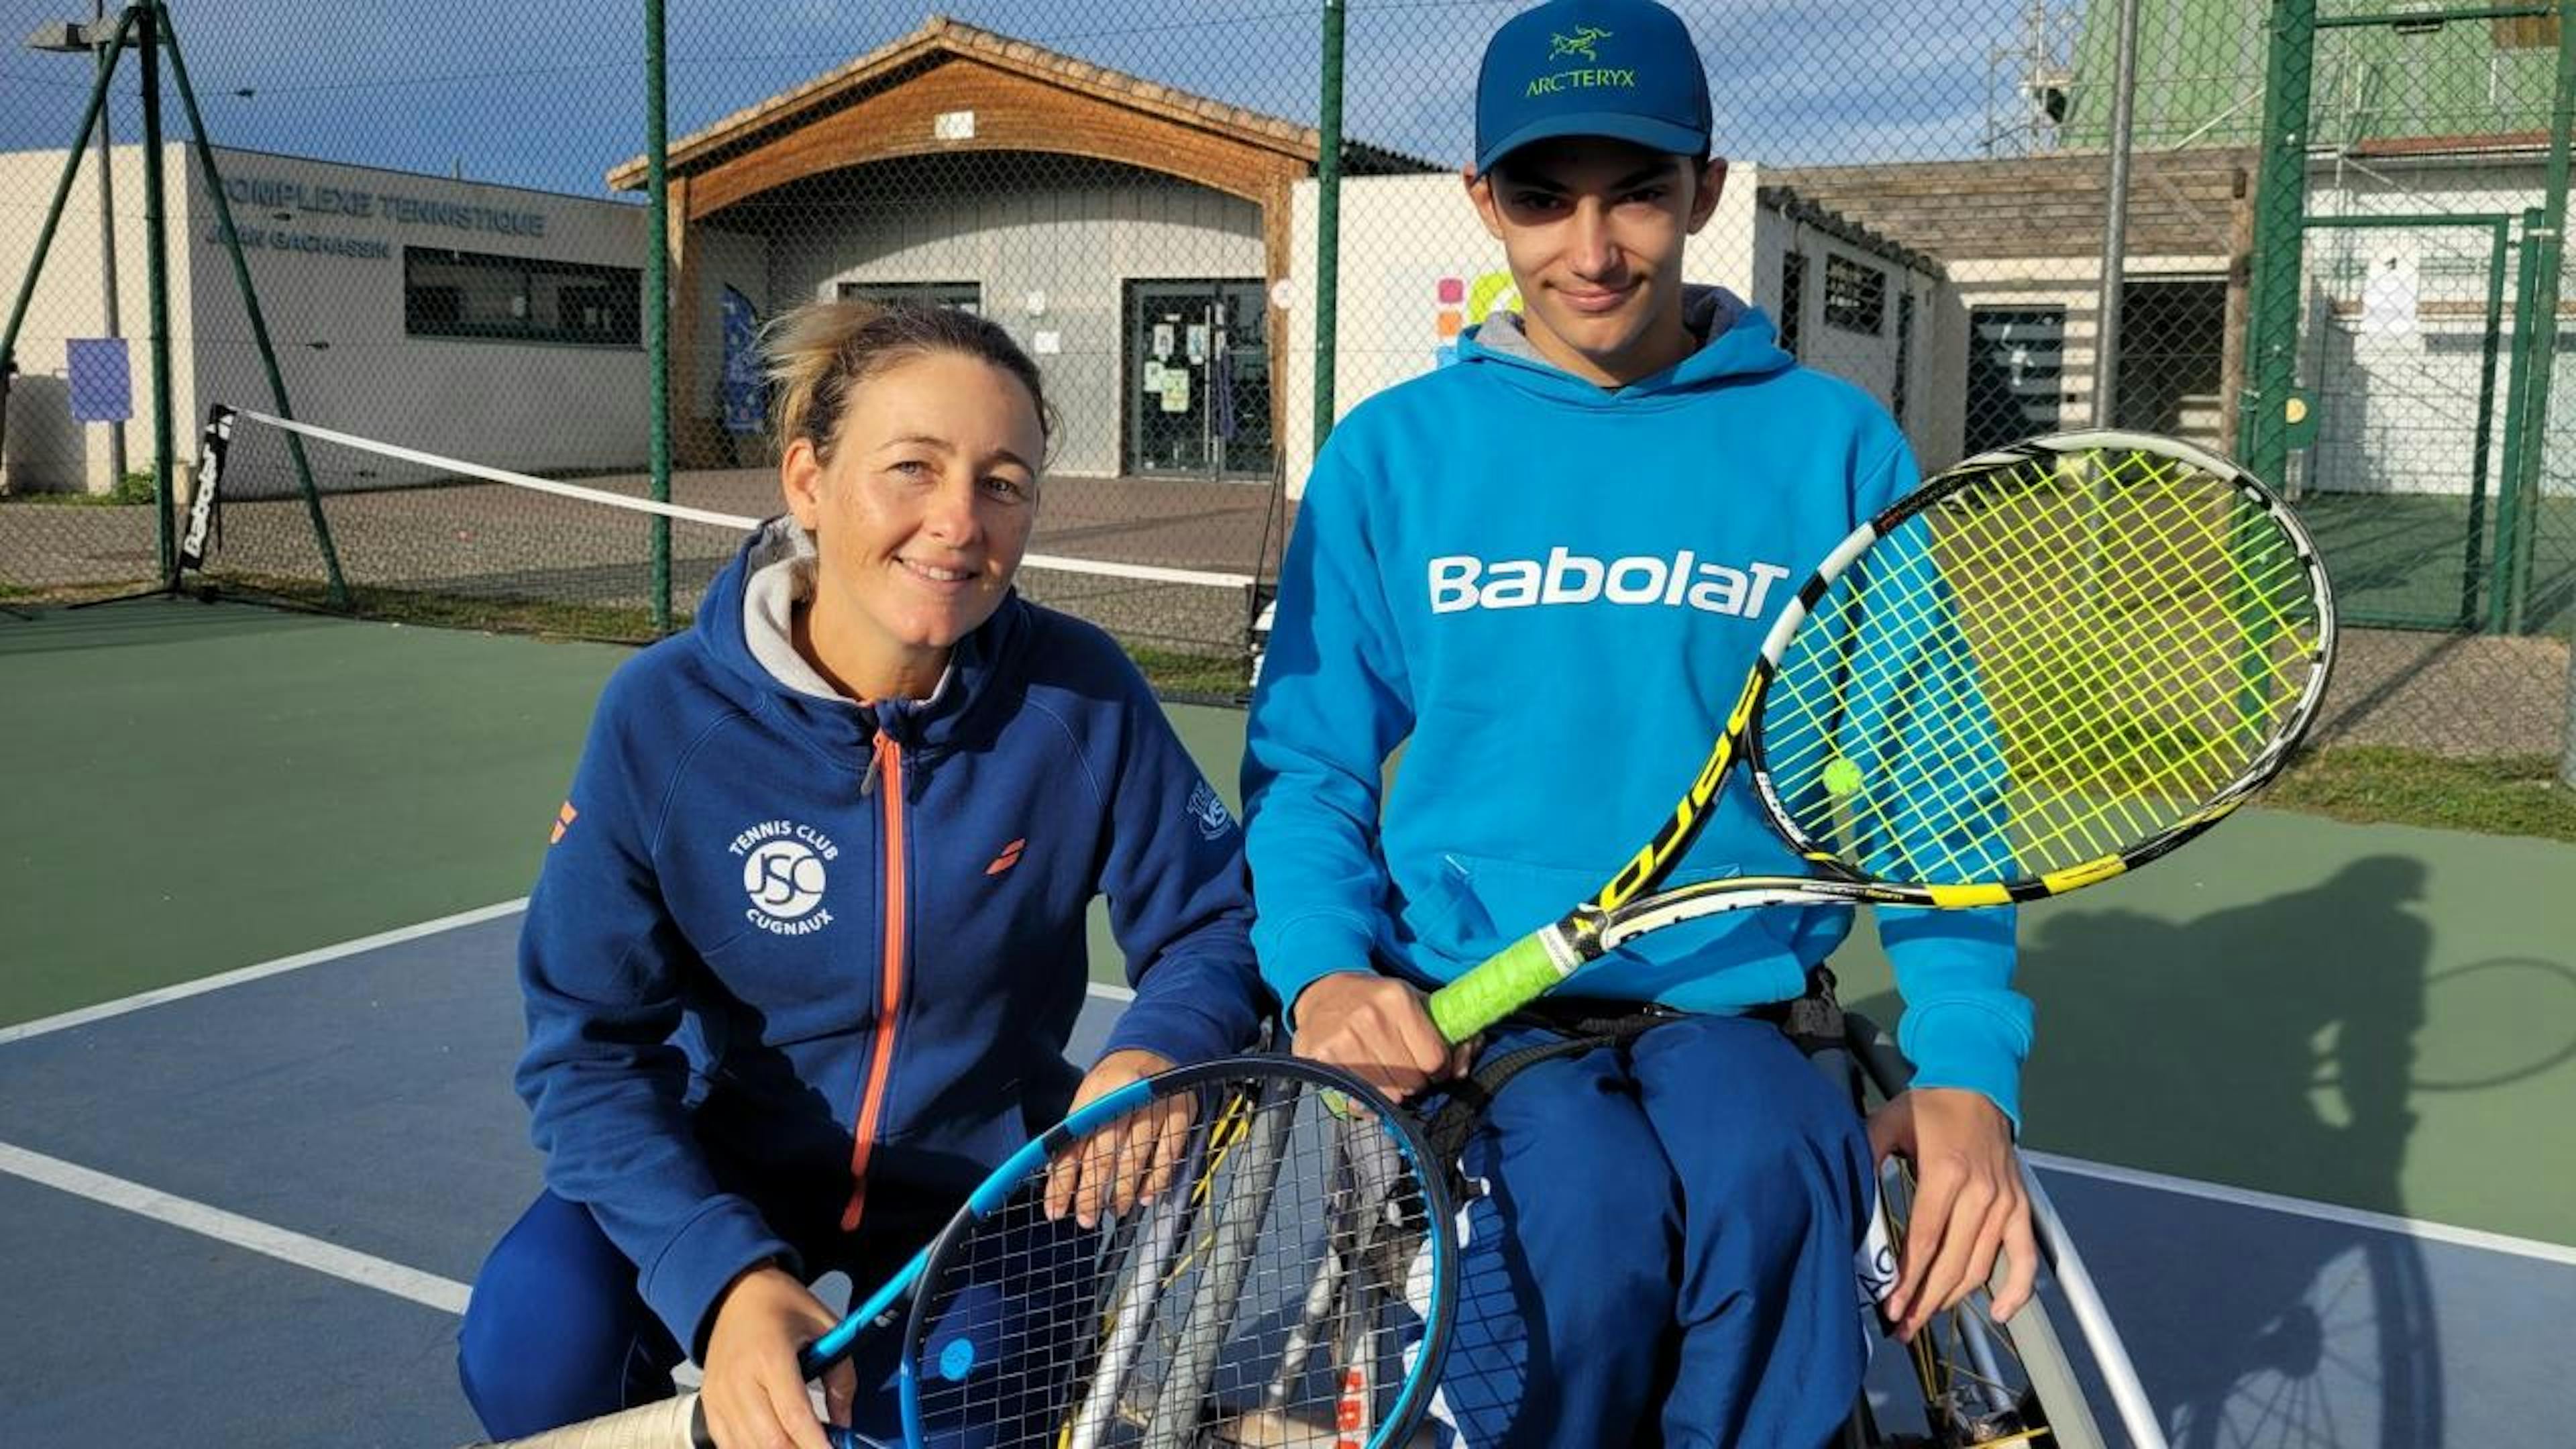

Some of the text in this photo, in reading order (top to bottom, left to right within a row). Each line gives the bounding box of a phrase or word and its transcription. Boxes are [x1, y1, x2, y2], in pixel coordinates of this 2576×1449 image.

[222, 176, 374, 217] OMPLEXE
[729, 820, 839, 861] TENNIS CLUB
[745, 908, 835, 935] CUGNAUX
